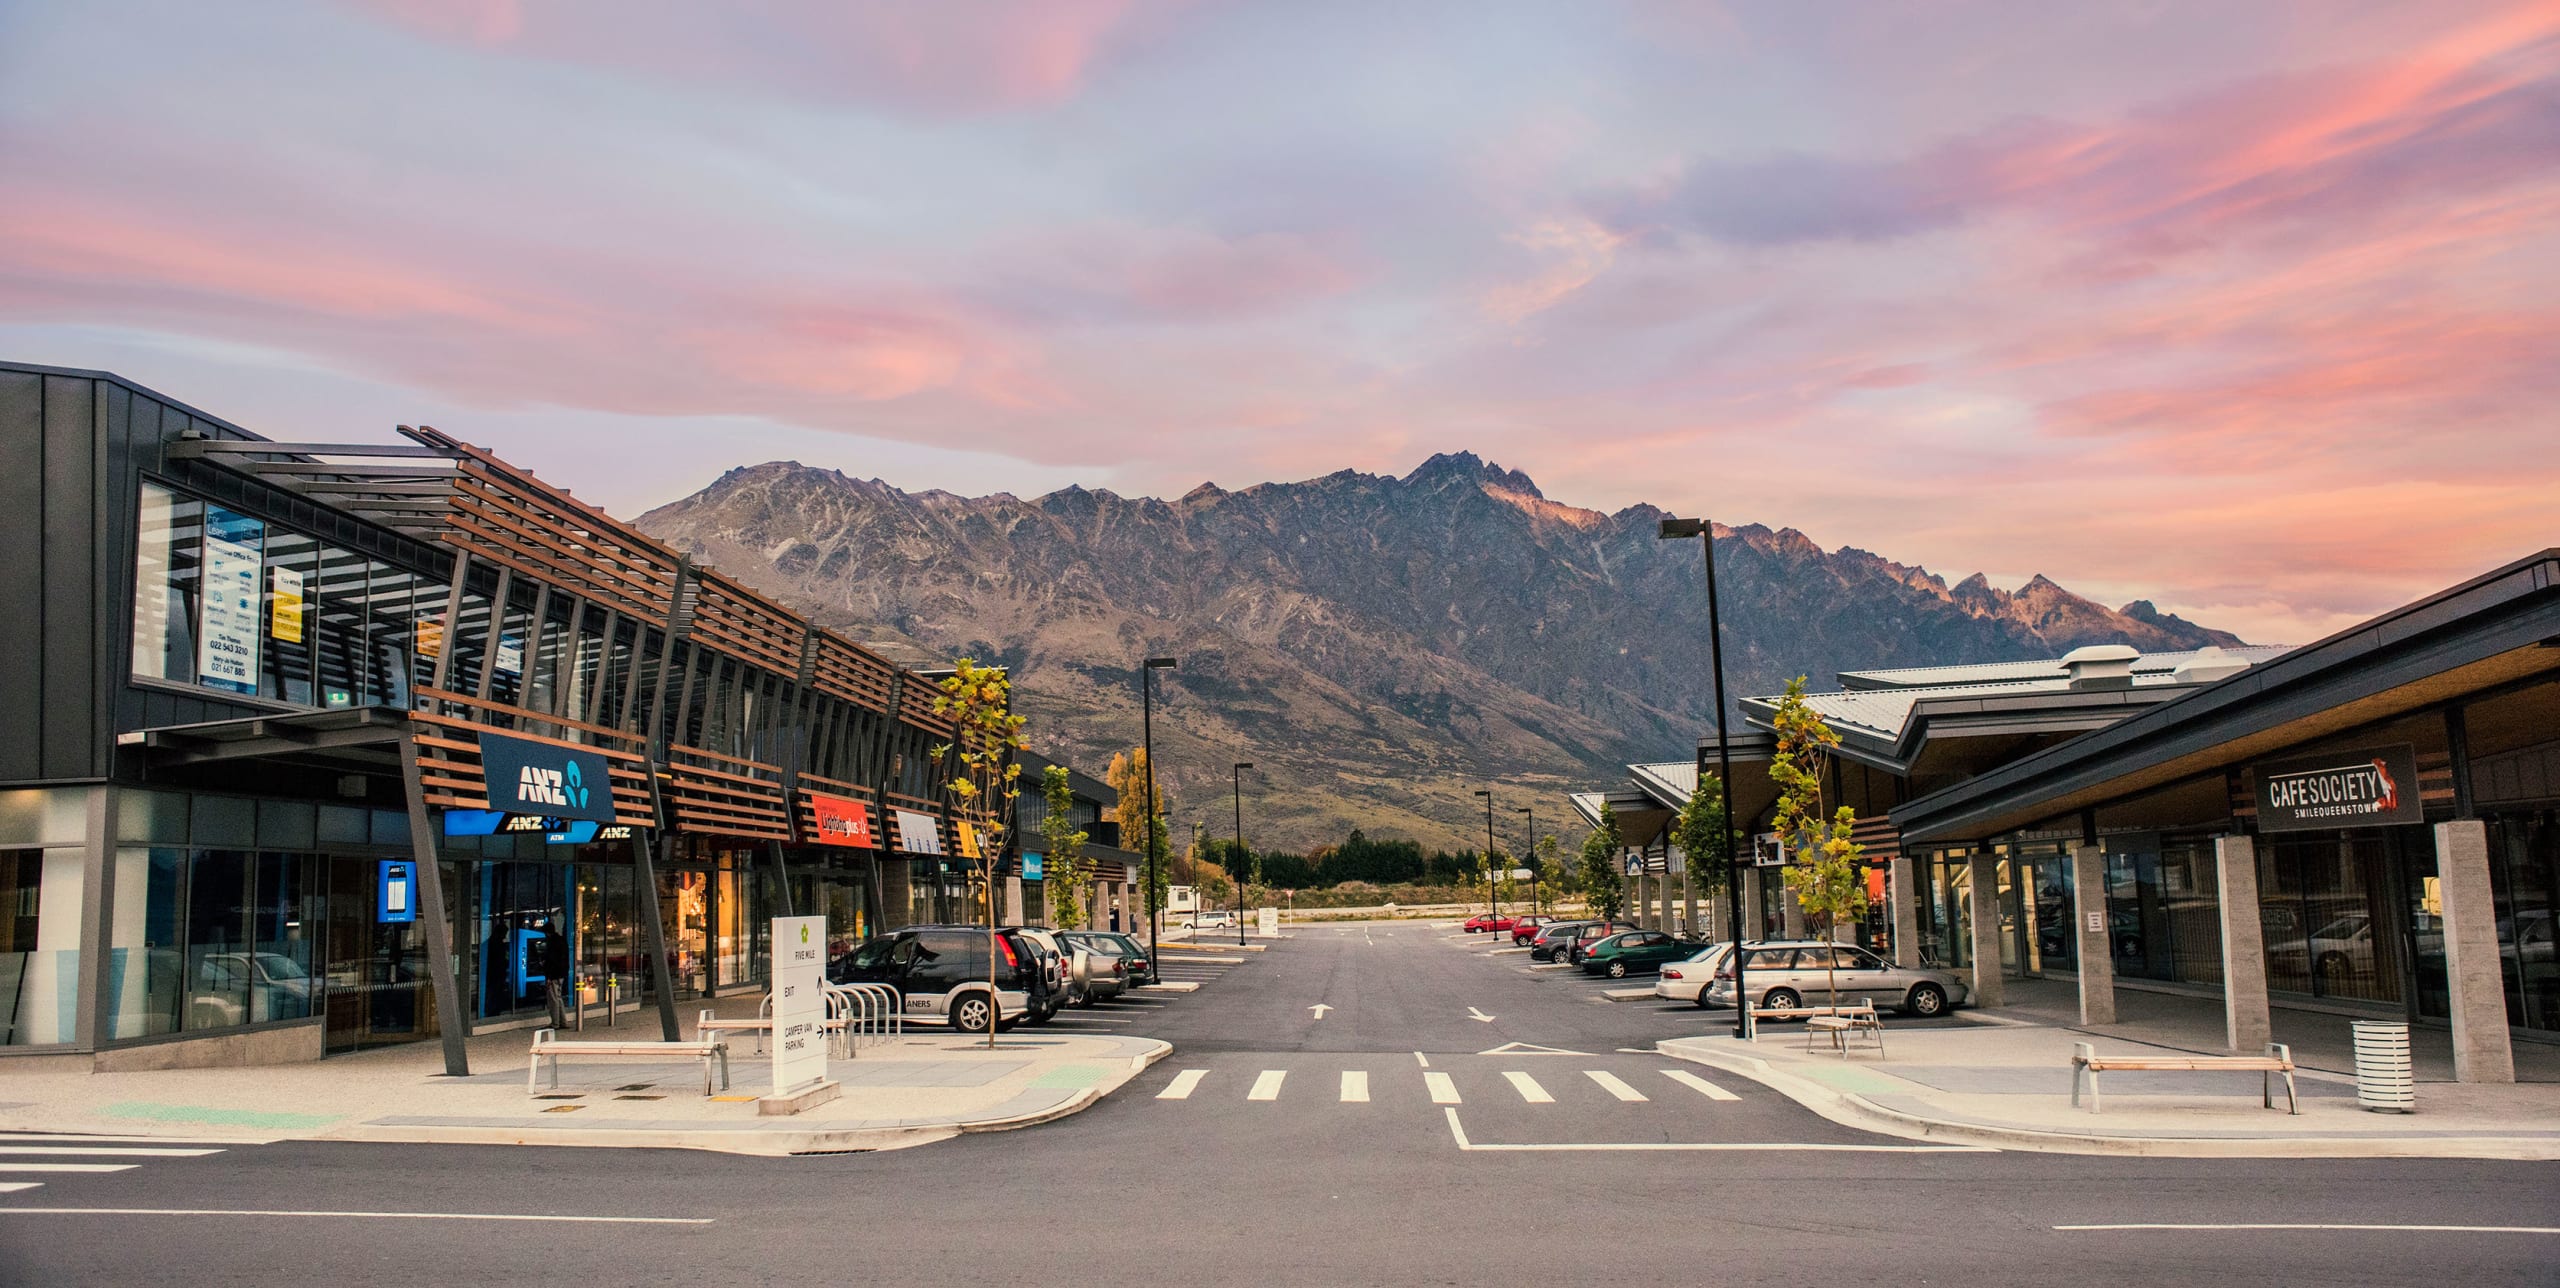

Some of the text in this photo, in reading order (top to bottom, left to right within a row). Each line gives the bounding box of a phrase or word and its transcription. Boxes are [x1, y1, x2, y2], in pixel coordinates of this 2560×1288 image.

[210, 640, 221, 650] 022
[211, 662, 222, 672] 021
[518, 765, 567, 806] ANZ
[2270, 770, 2377, 808] CAFE SOCIETY
[506, 816, 543, 831] ANZ
[600, 827, 631, 839] ANZ
[795, 949, 815, 960] FIVE MILE
[784, 985, 795, 998] EXIT
[785, 1022, 813, 1038] CAMPER VAN
[785, 1038, 805, 1052] PARKING
